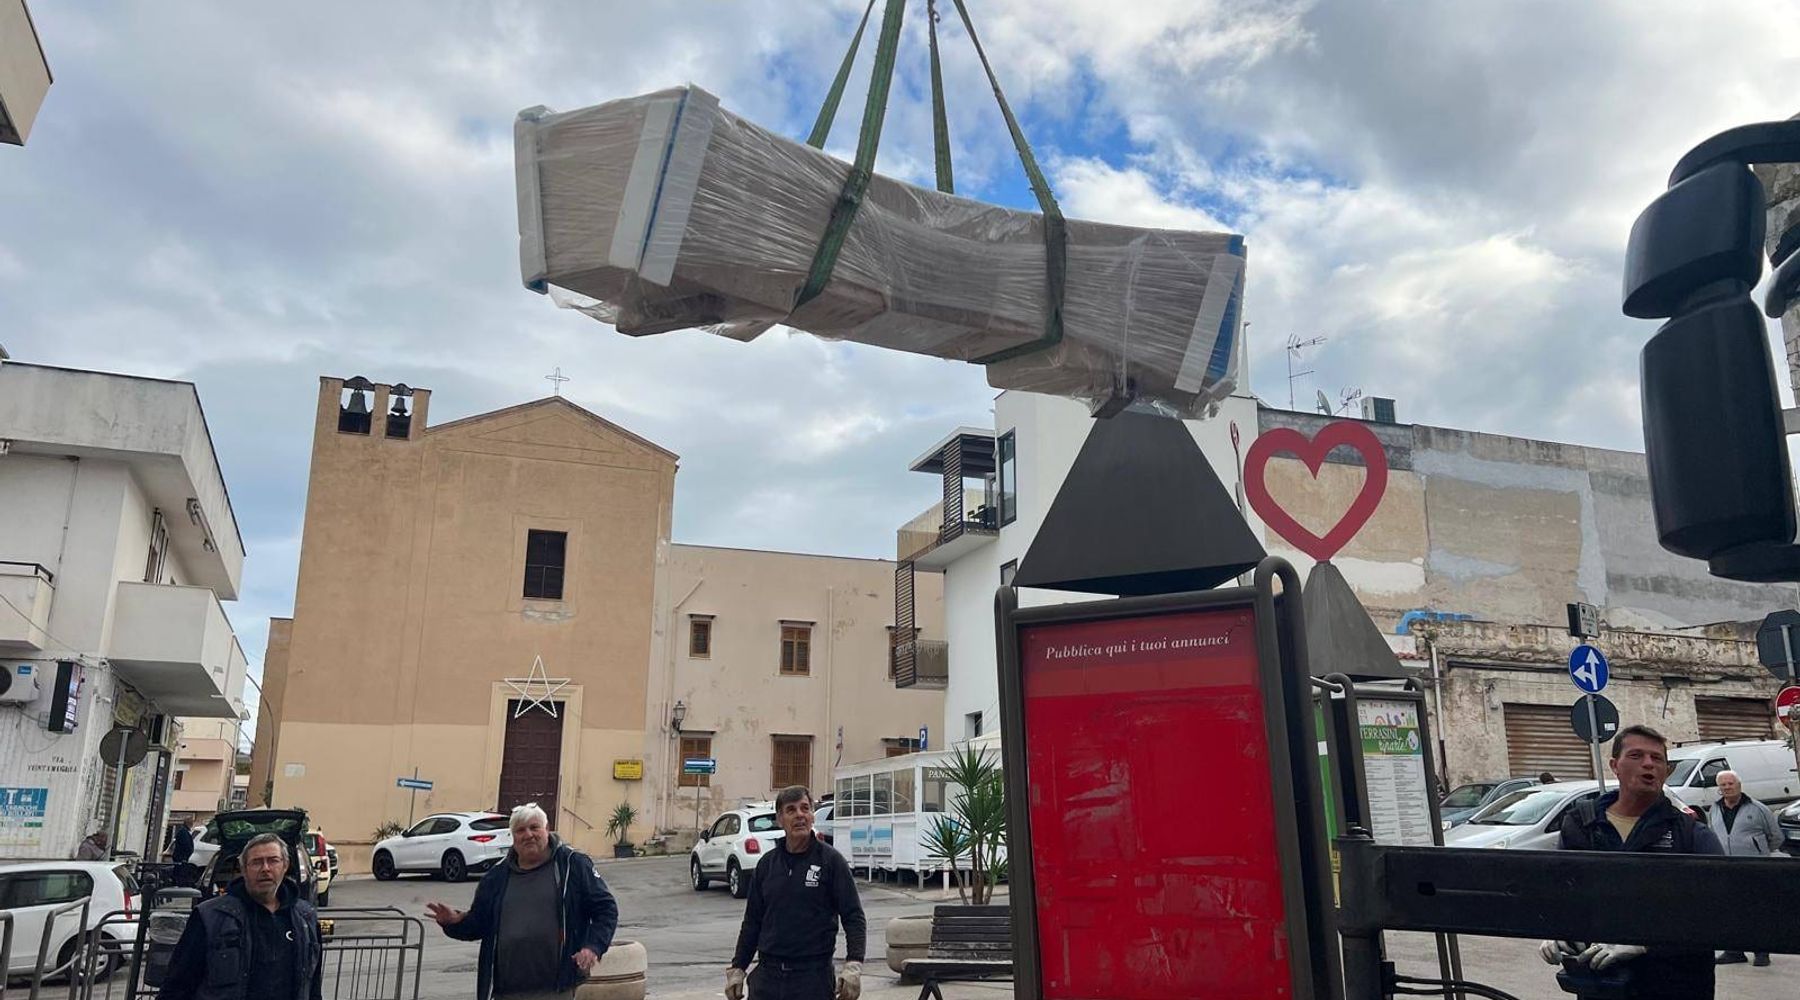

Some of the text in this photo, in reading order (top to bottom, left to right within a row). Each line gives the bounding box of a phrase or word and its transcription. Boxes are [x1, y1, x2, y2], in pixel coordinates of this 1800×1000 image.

[1046, 631, 1229, 659] Pubblica qui i tuoi annunci
